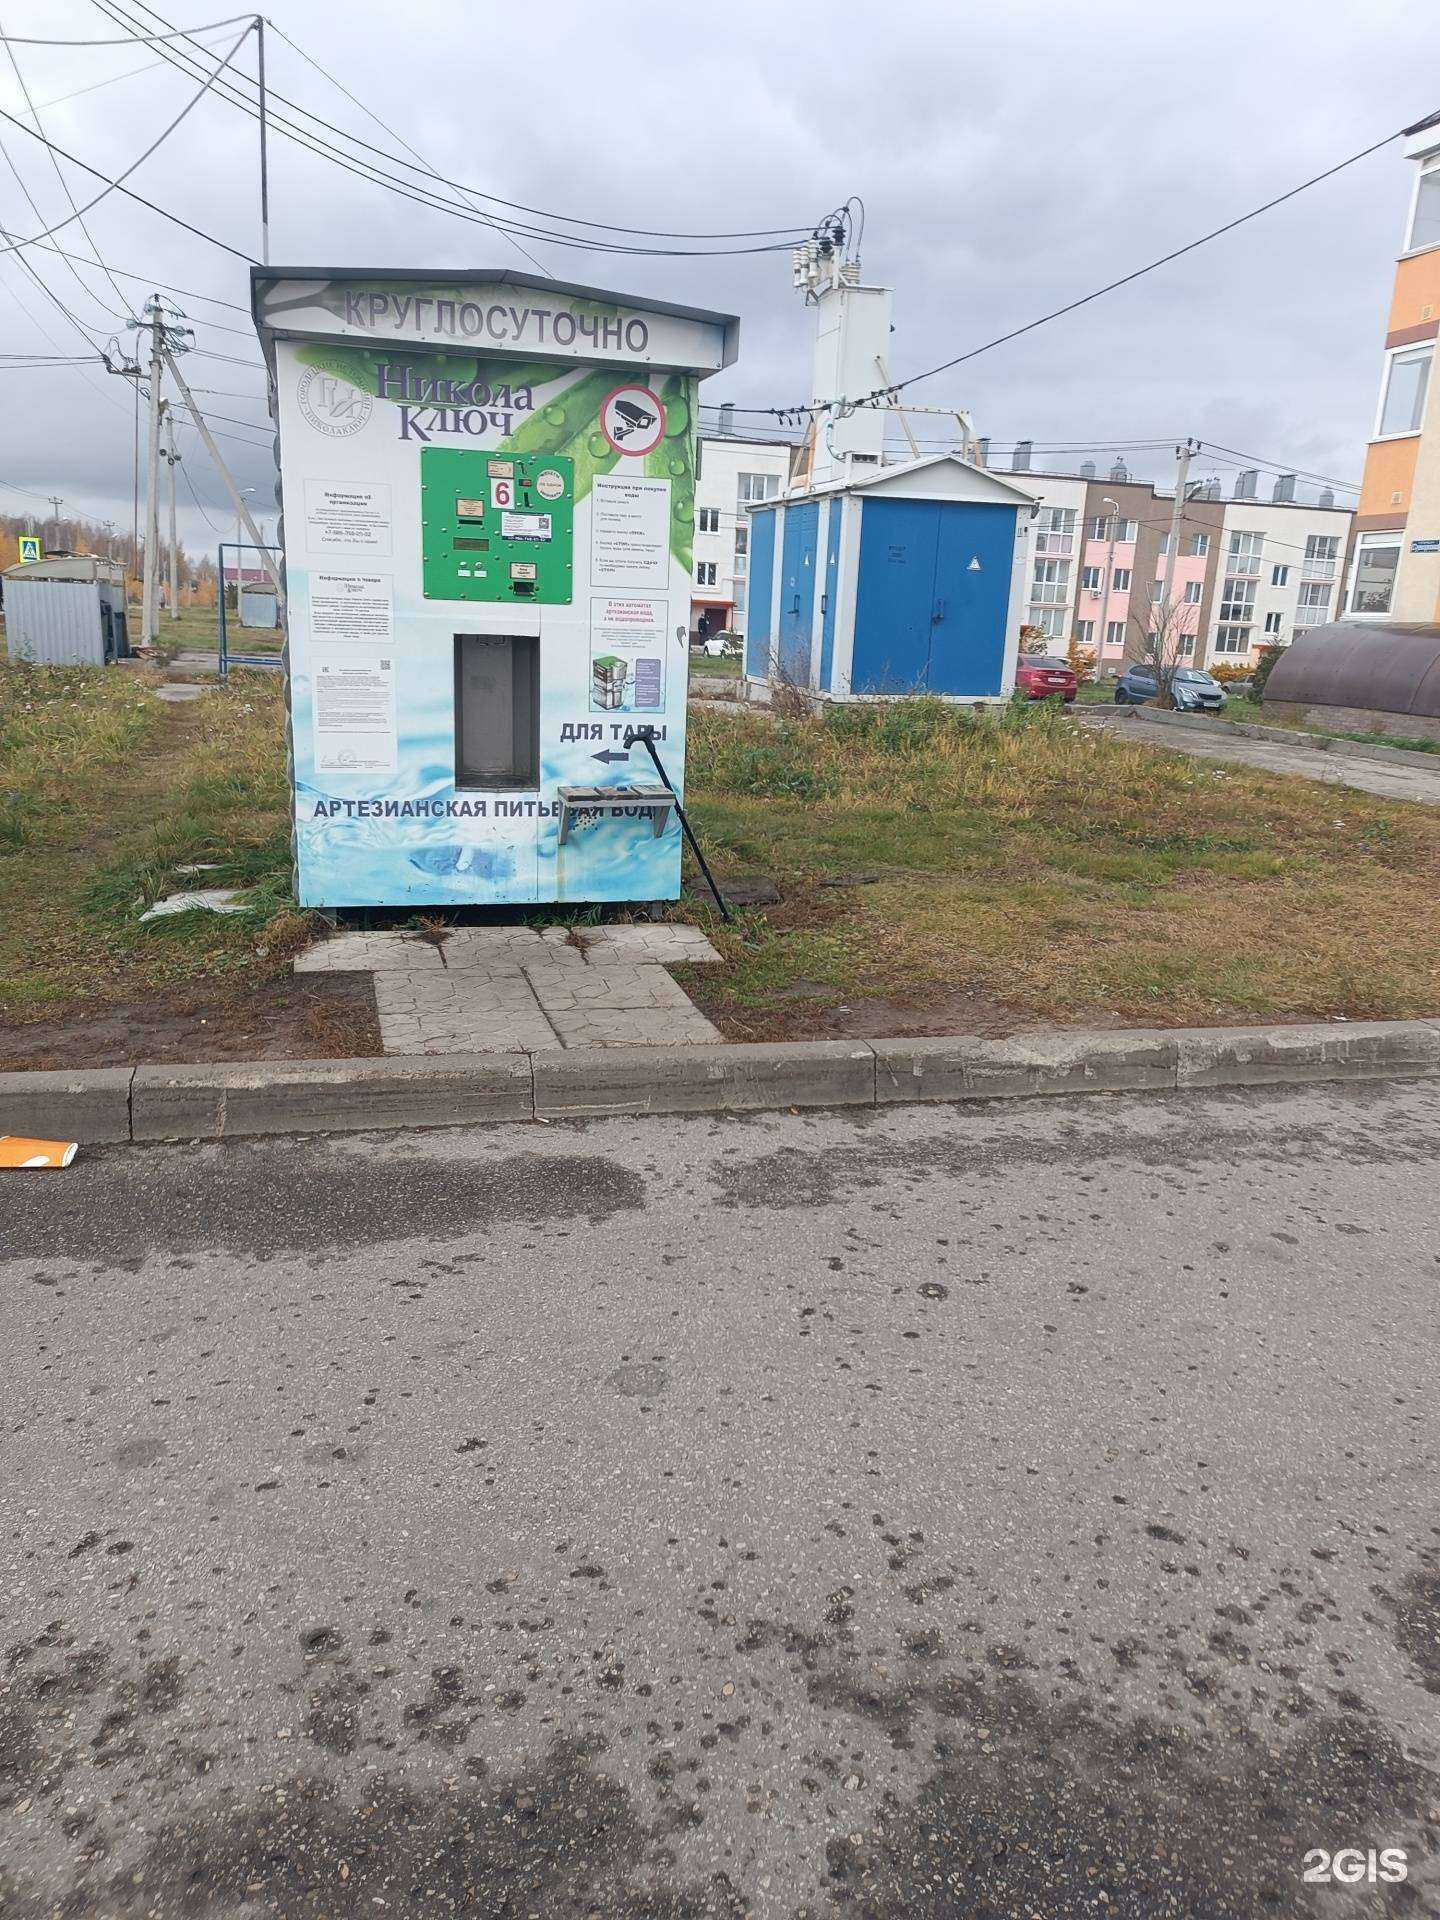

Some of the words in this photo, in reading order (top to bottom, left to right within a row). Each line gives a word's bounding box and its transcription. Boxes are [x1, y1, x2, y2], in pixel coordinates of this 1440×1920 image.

[345, 290, 649, 353] КРУГЛОСУТОЧНО
[374, 362, 535, 411] Никола
[398, 405, 515, 442] Ключ
[495, 482, 510, 506] 6
[560, 723, 603, 743] ДЛЯ
[610, 724, 667, 741] ТАРЫ
[313, 800, 487, 817] АРТЕЗИАНСКАЯ
